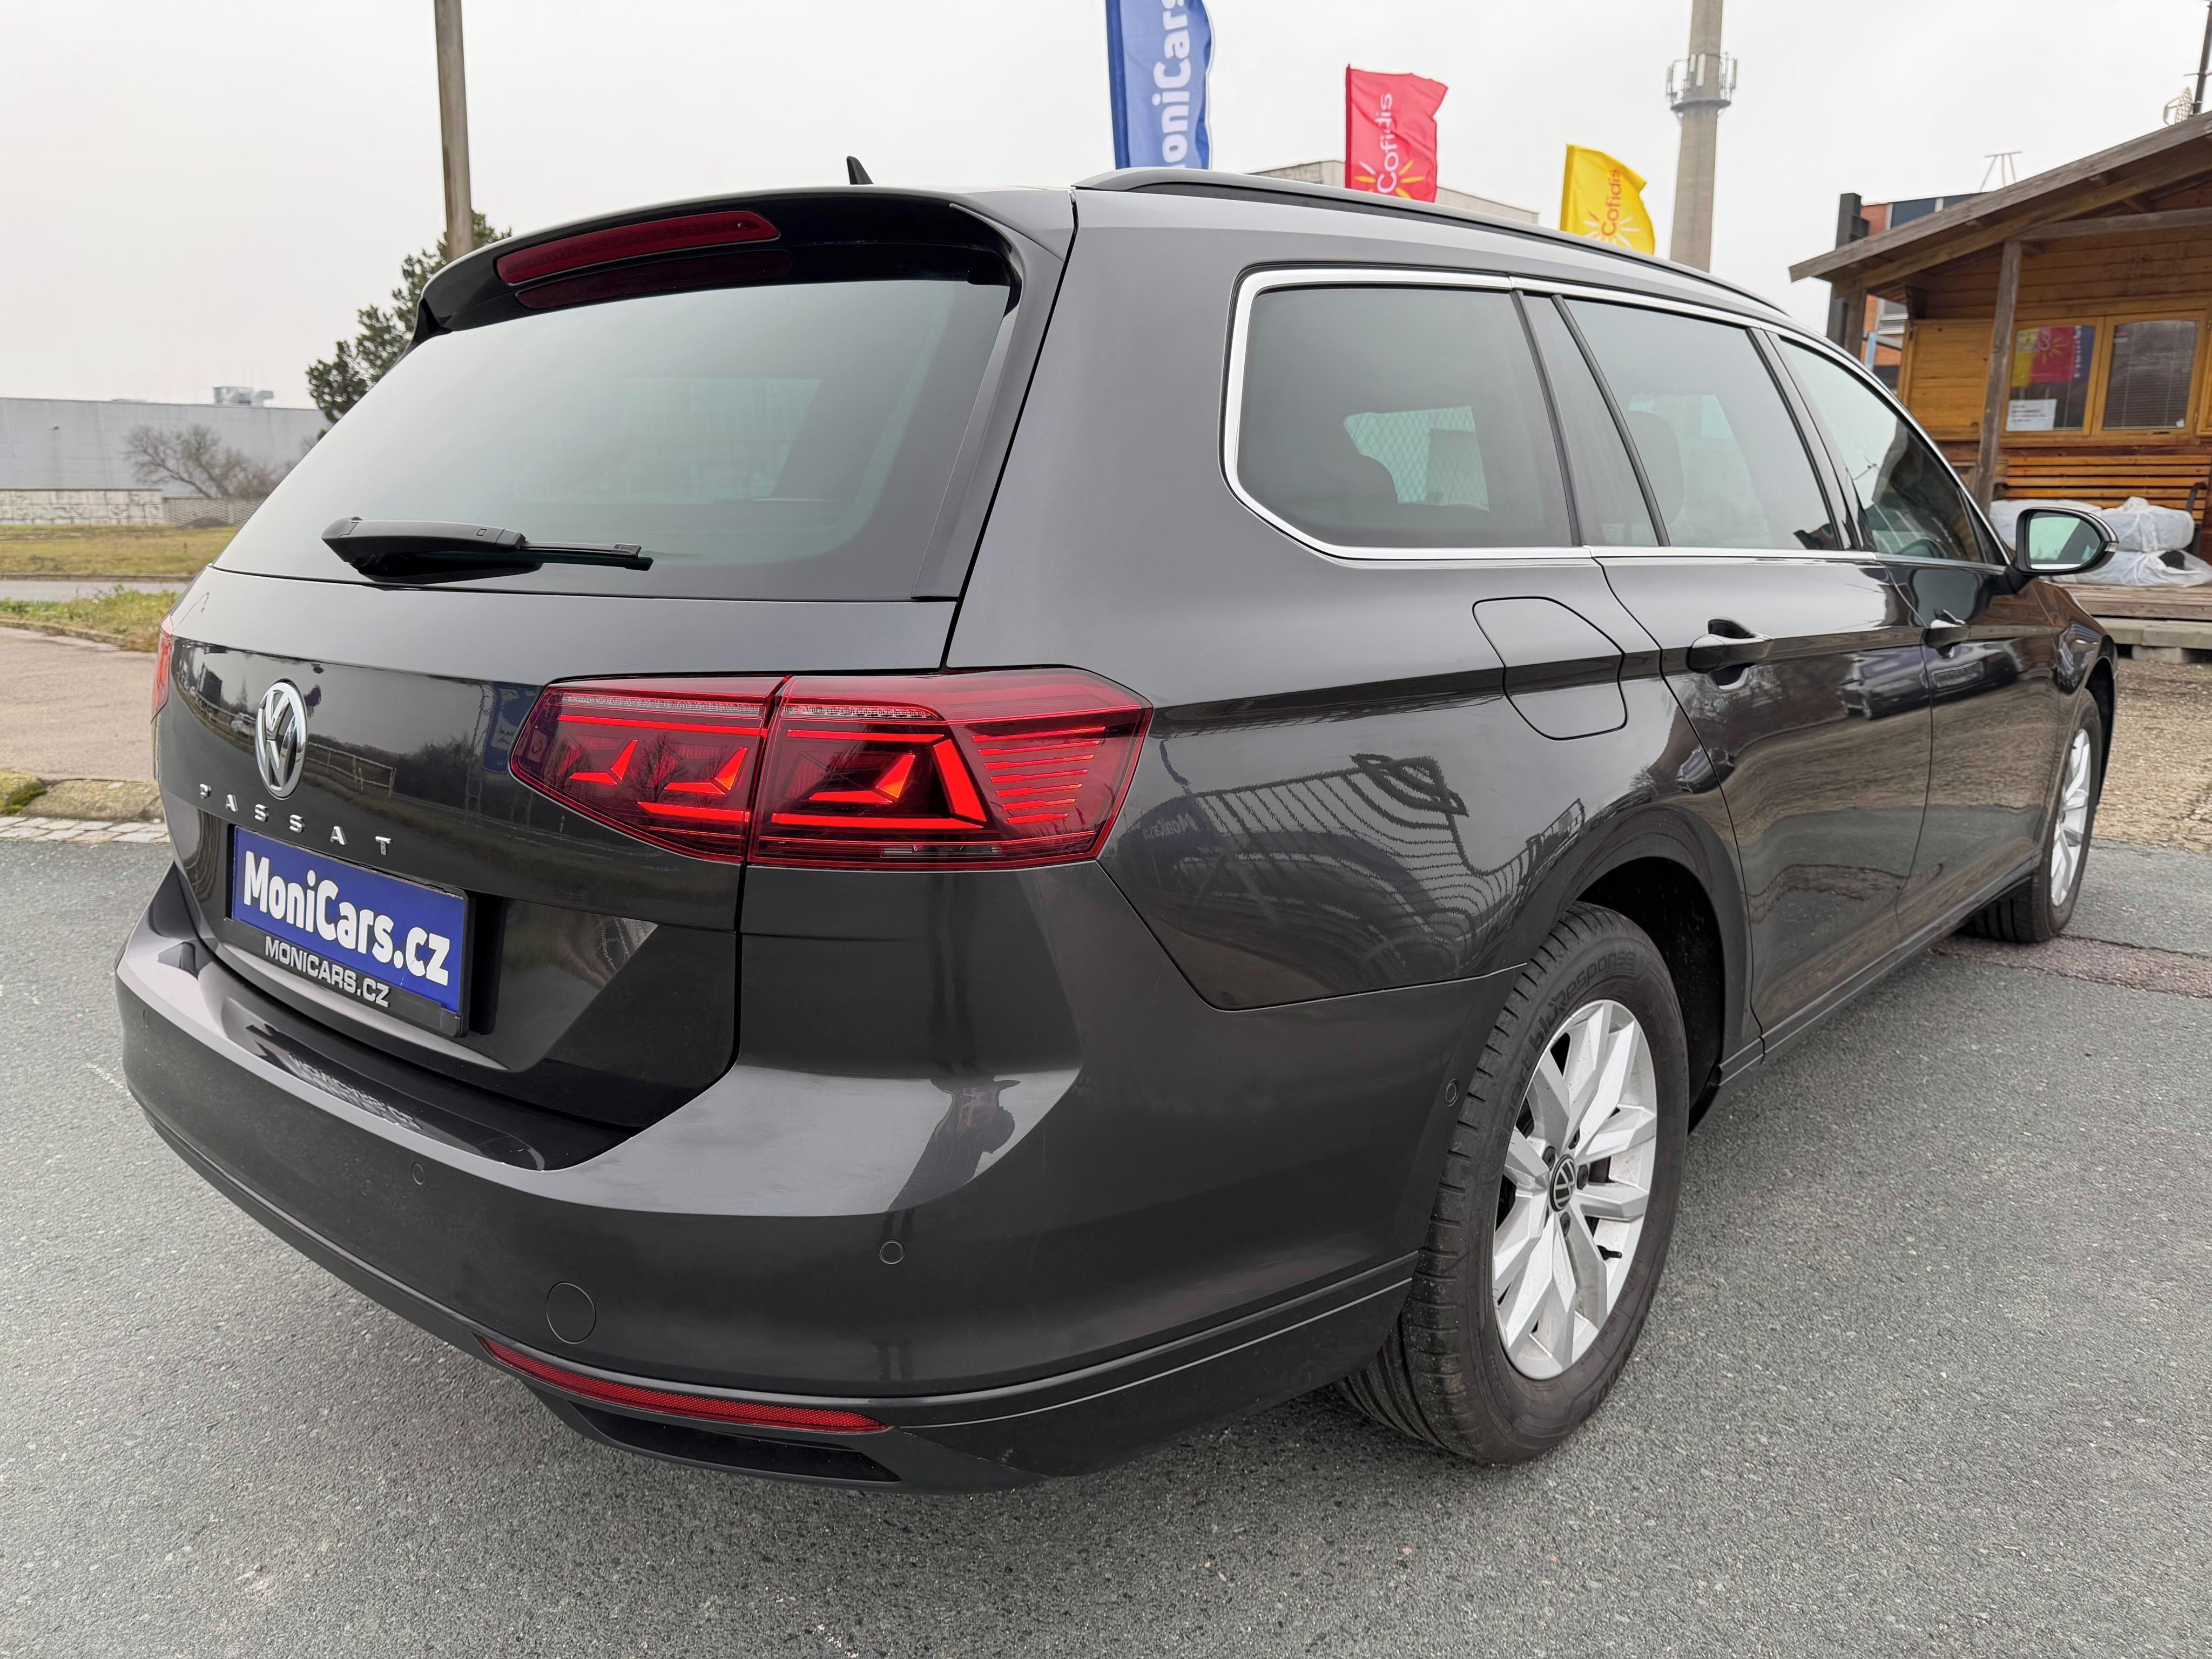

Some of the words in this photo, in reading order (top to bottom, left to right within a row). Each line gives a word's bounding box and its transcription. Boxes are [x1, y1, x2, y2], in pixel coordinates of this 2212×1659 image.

[1151, 0, 1191, 168] oniCar
[1377, 92, 1399, 193] Cofidis
[1601, 168, 1622, 236] Cofidis
[199, 784, 394, 855] PASSAT
[244, 850, 450, 986] MoniCars.cz
[265, 936, 390, 1008] MONICARS.CZ
